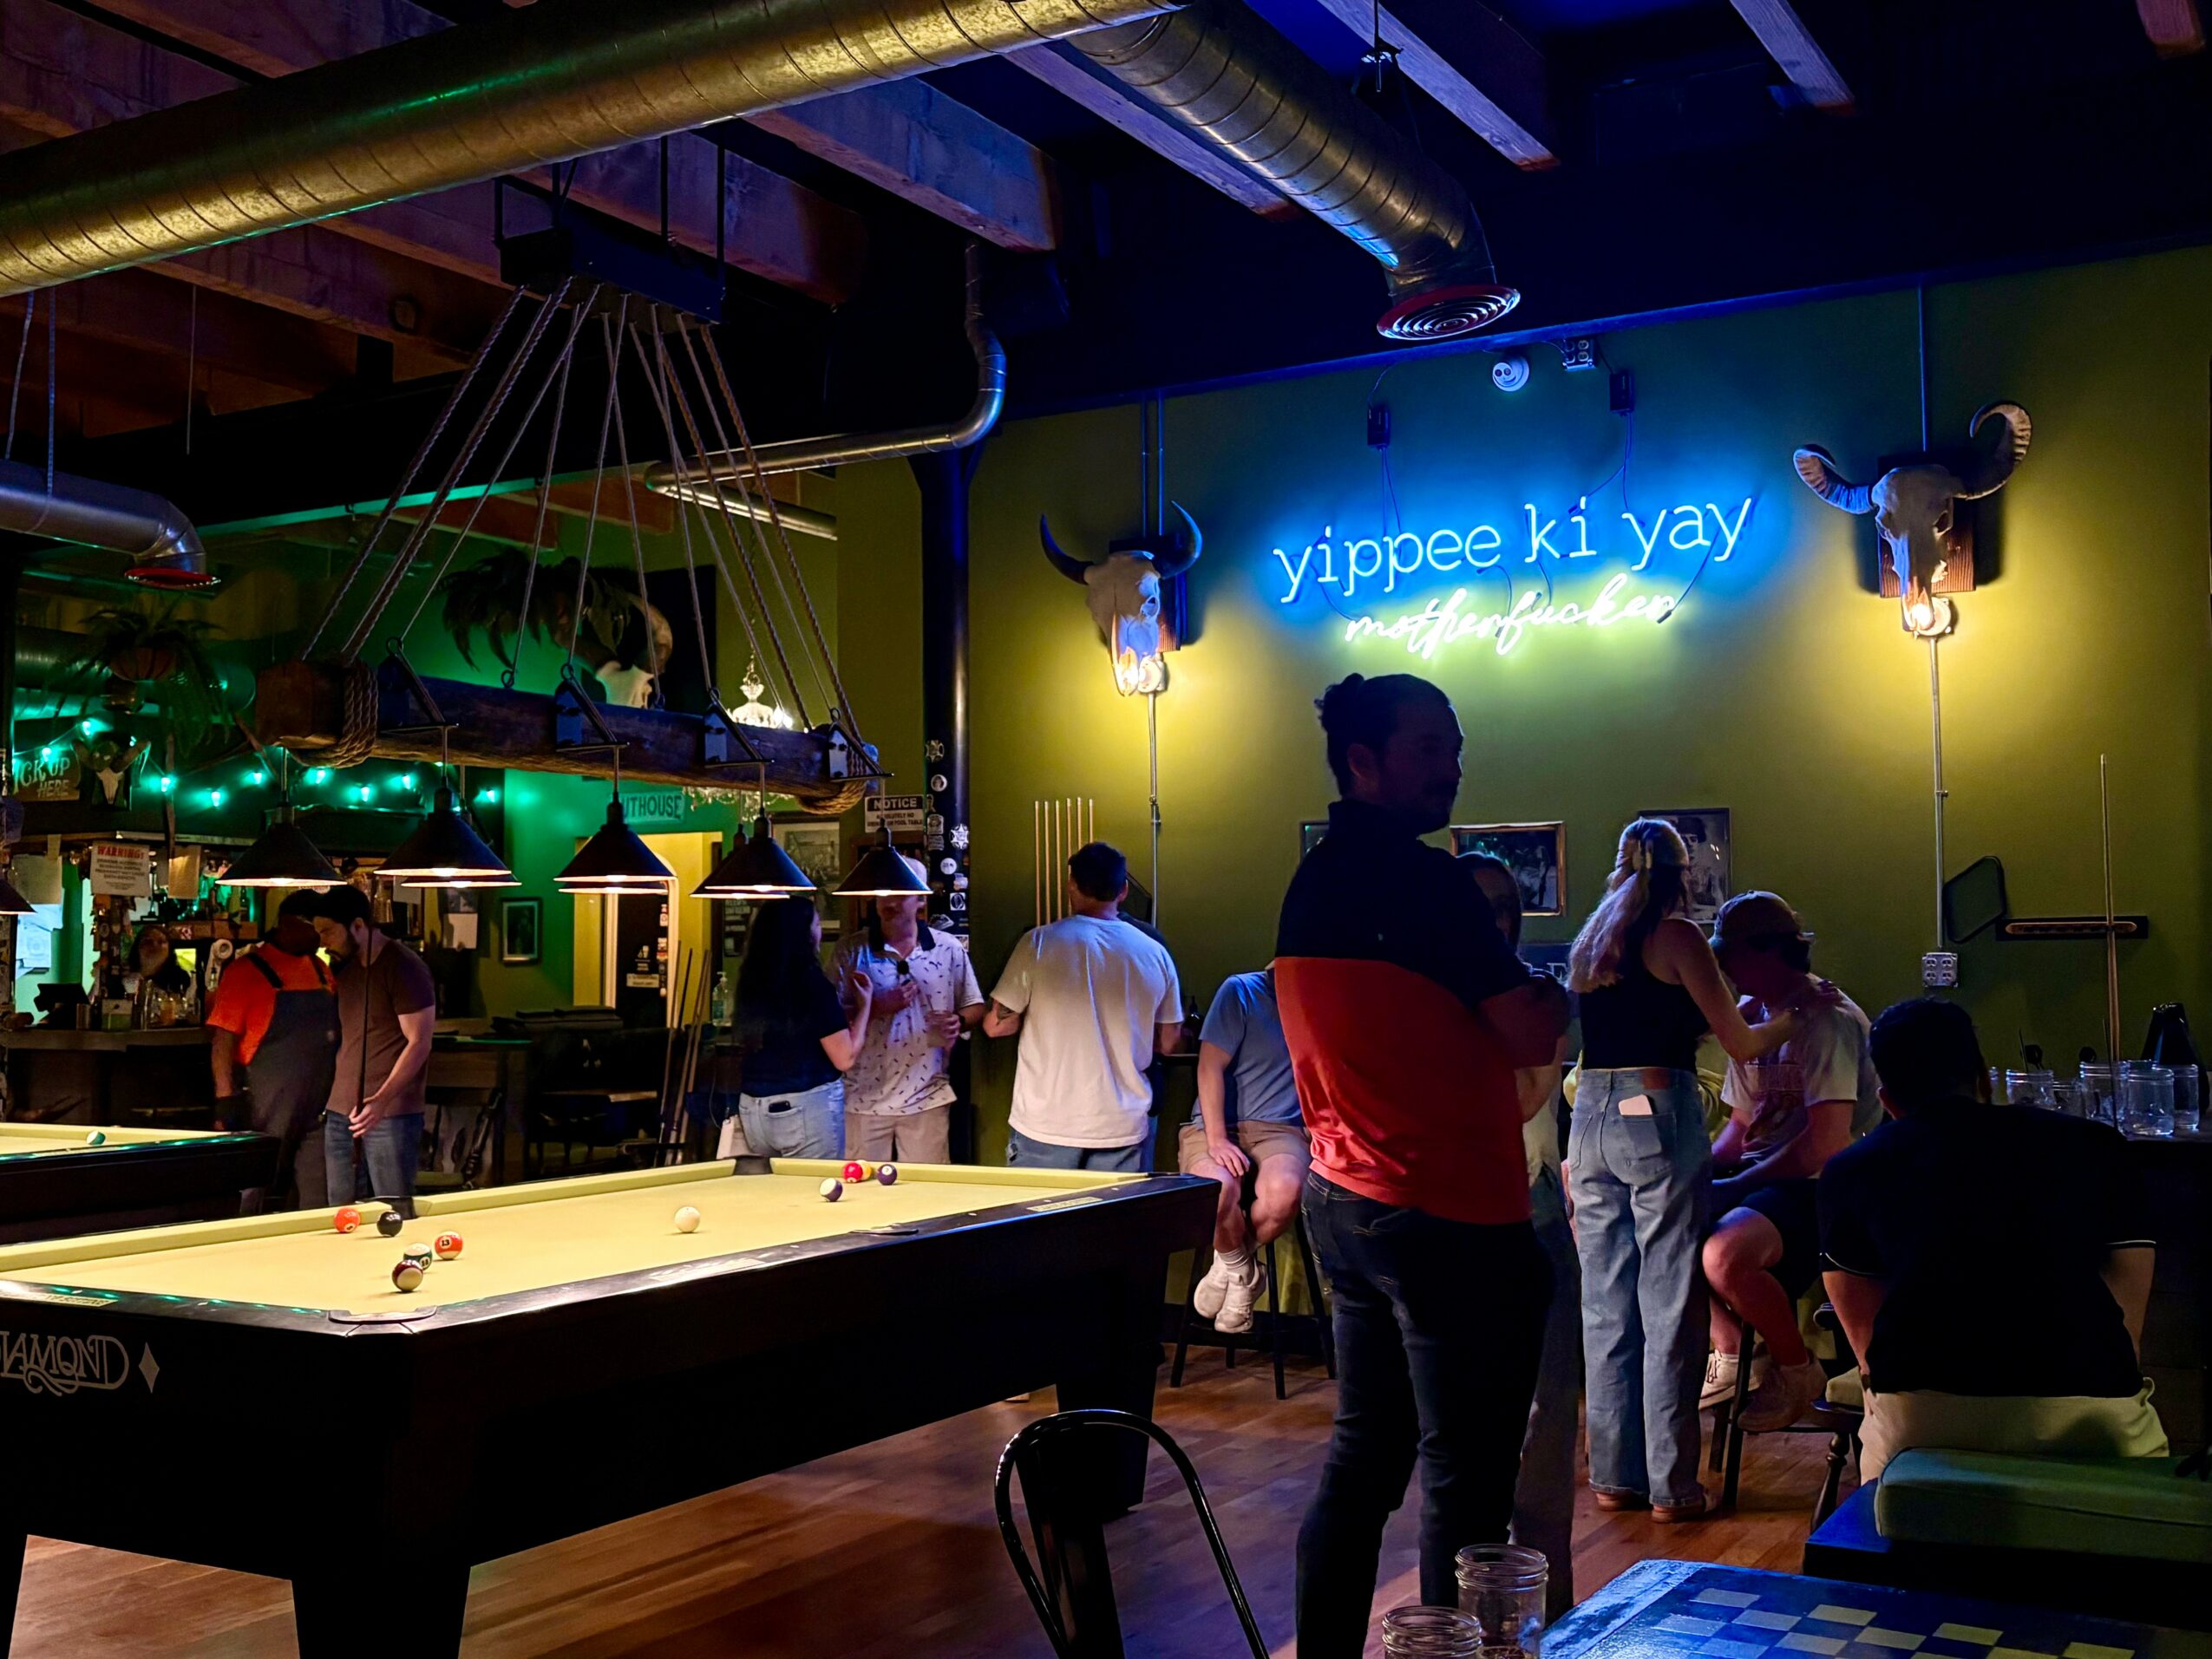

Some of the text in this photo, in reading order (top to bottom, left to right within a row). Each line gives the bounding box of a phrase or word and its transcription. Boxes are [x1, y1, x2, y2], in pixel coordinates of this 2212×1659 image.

[1273, 496, 1752, 604] yippee ki yay
[1344, 572, 1678, 659] motherfucker
[36, 779, 69, 798] HERE
[622, 795, 682, 820] UTHOUSE
[874, 797, 918, 810] NOTICE
[441, 1238, 450, 1247] 13
[0, 1330, 129, 1395] IAMOND
